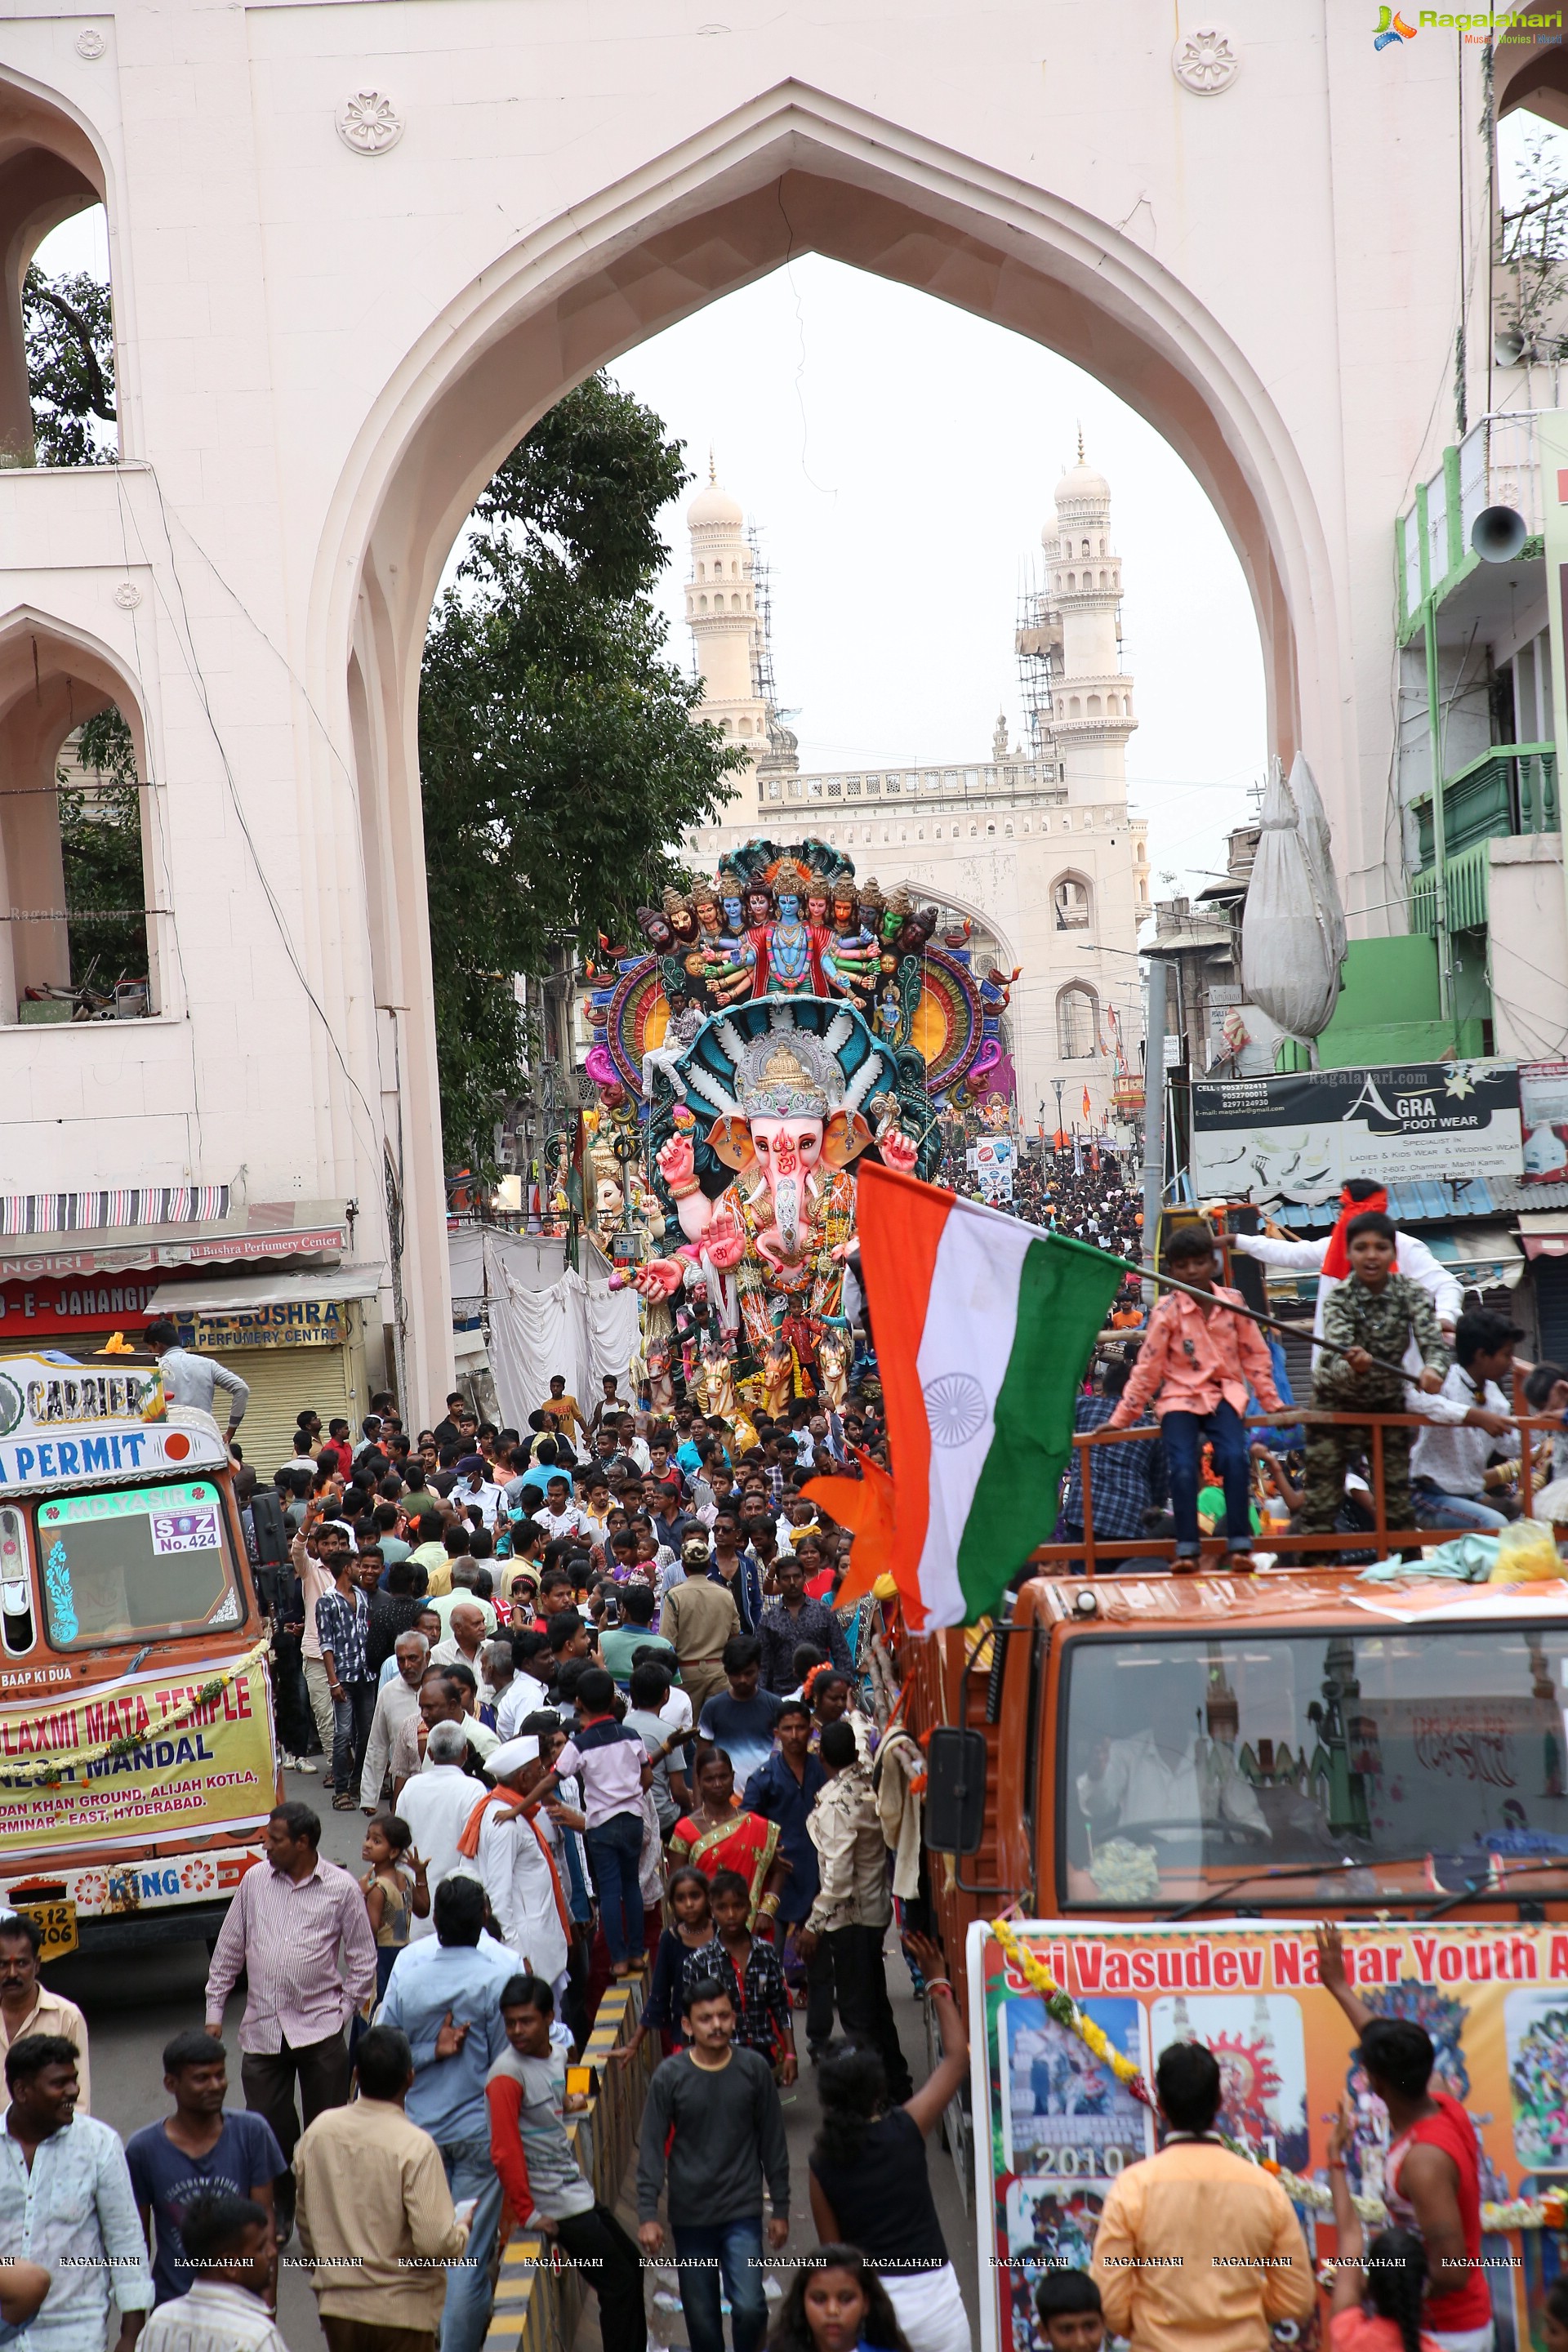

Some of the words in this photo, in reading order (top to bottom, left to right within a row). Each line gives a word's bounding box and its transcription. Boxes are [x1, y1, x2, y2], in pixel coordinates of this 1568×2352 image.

[1221, 1083, 1267, 1091] 9052702413
[1222, 1091, 1267, 1099] 9052700015
[1403, 1118, 1437, 1130] FOOT
[1441, 1116, 1478, 1128] WEAR
[203, 1244, 241, 1255] Bushra
[244, 1238, 298, 1253] Perfumery
[301, 1236, 337, 1248] Center
[3, 1255, 81, 1274] NGIRI
[198, 1330, 279, 1346] PERFUMERY
[286, 1327, 338, 1342] CENTRE
[27, 1377, 145, 1425] CARRIER
[549, 1405, 571, 1414] SPEED
[15, 1432, 145, 1481] PERMIT
[67, 1487, 187, 1520] MD.YASIR
[1, 1672, 32, 1687] BAAP
[34, 1670, 47, 1683] KI
[49, 1668, 72, 1682] DUA
[0, 1708, 79, 1757] LAXMI
[84, 1695, 150, 1744] MATA
[154, 1677, 252, 1732] TEMPLE
[86, 1734, 214, 1779] MANDAL
[33, 1797, 74, 1813] KHAN
[79, 1788, 146, 1807] GROUND,
[150, 1779, 202, 1798] ALIJAH
[206, 1771, 258, 1788] KOTLA,
[69, 1810, 109, 1826] EAST,
[114, 1796, 207, 1819] HYDERABAD.
[109, 1869, 180, 1901] KING
[1071, 1940, 1264, 1991] Vasudev
[1271, 1938, 1405, 1989] Naar
[1410, 1934, 1538, 1985] Youth
[1035, 2145, 1125, 2178] 2010
